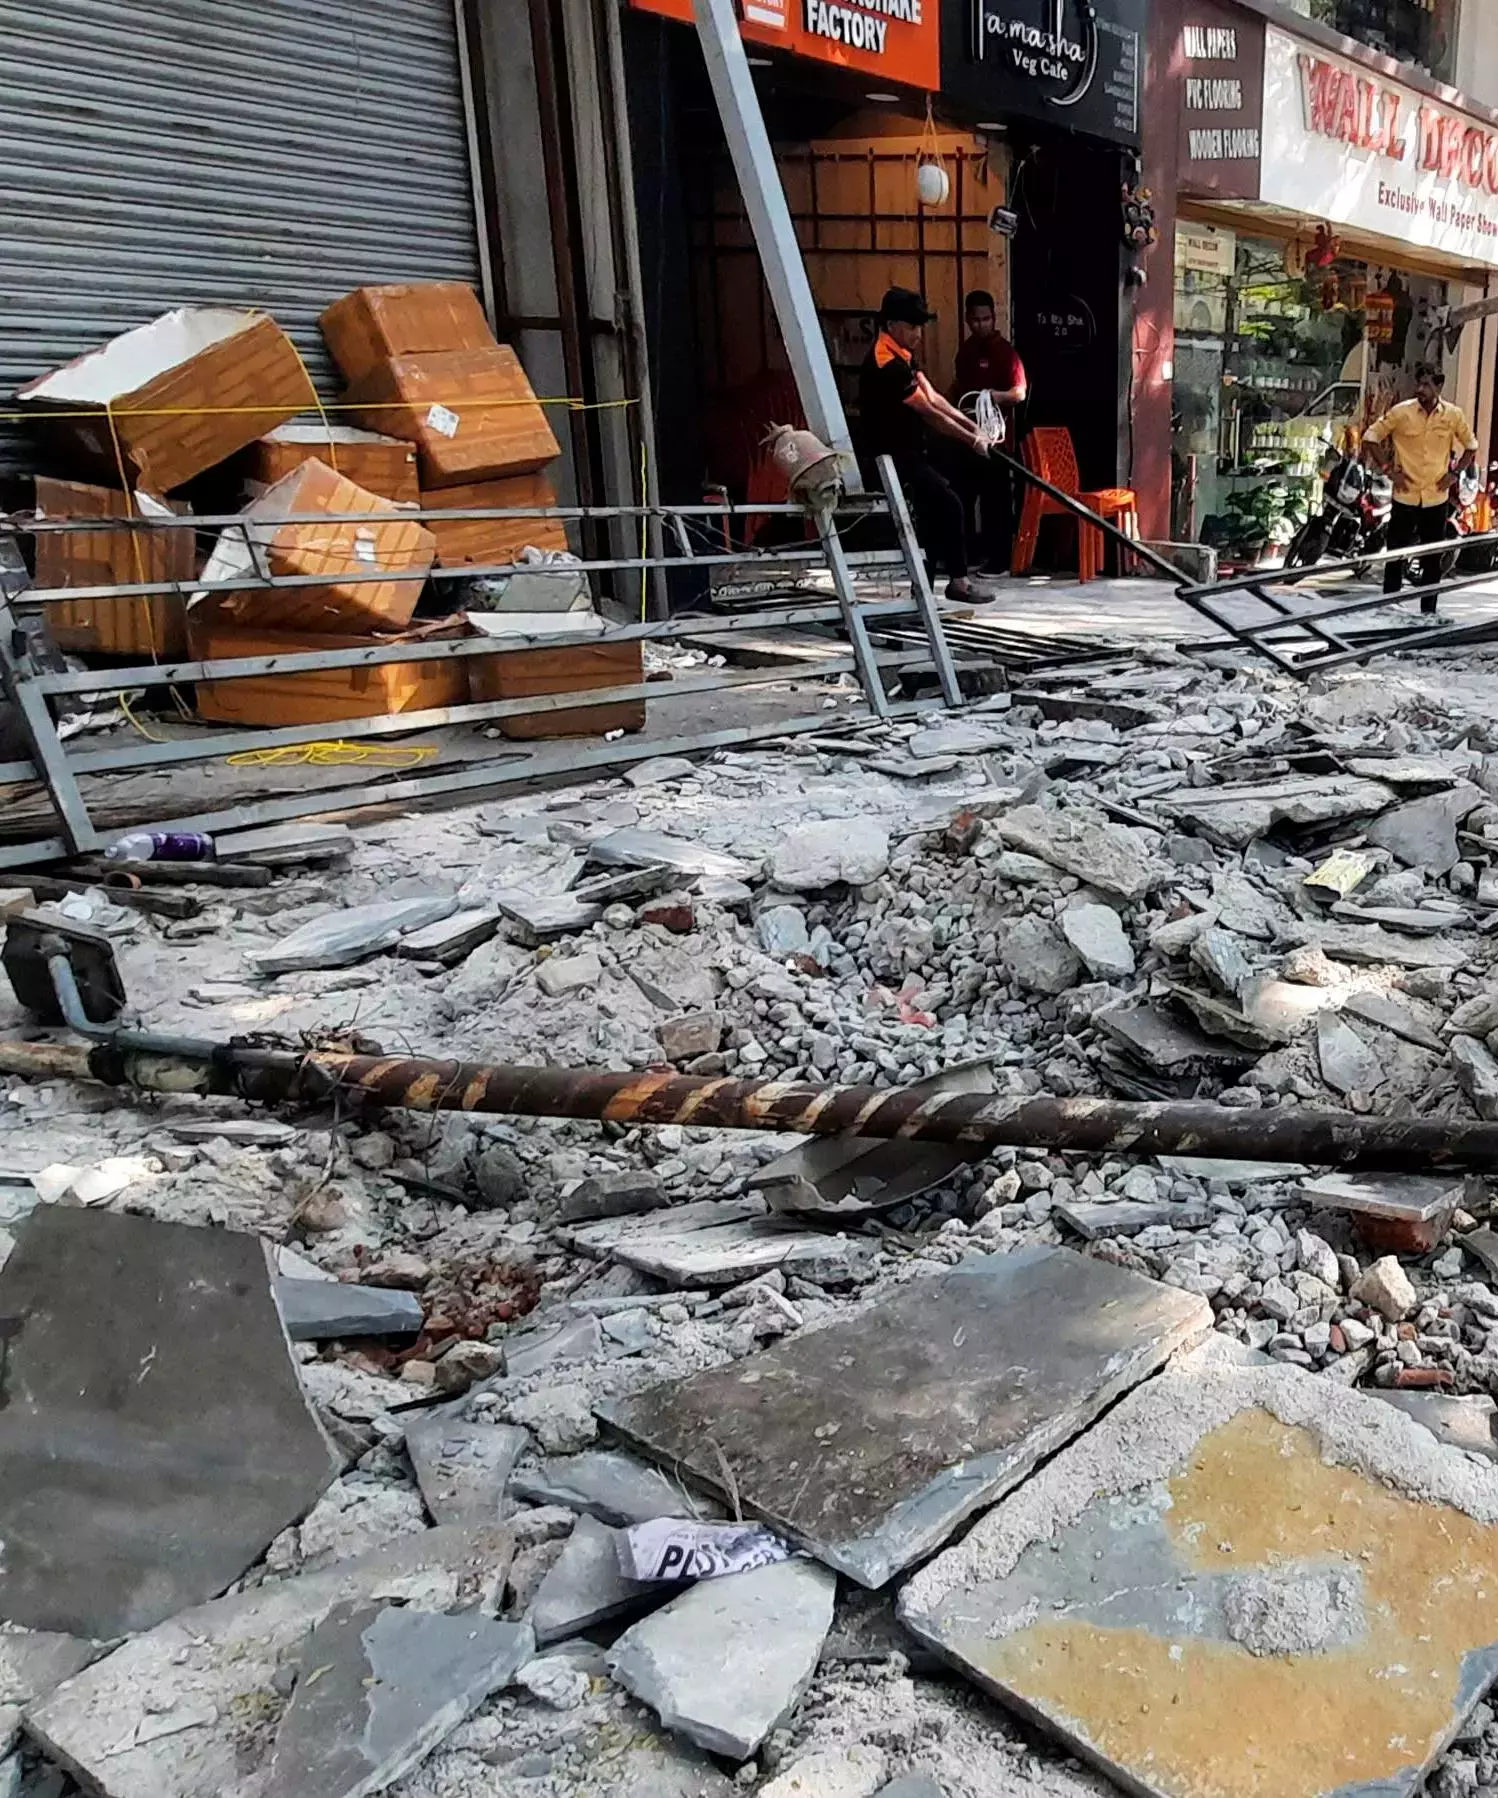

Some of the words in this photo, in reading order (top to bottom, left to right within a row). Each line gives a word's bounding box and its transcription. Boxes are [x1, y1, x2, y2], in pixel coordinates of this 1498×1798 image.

[806, 0, 887, 54] FACTORY
[1012, 48, 1038, 76] Veg
[1040, 57, 1068, 81] Cafe
[1186, 78, 1202, 109] PVC
[1298, 53, 1406, 160] WALL
[1429, 197, 1447, 222] Wall
[1451, 204, 1475, 232] Paper
